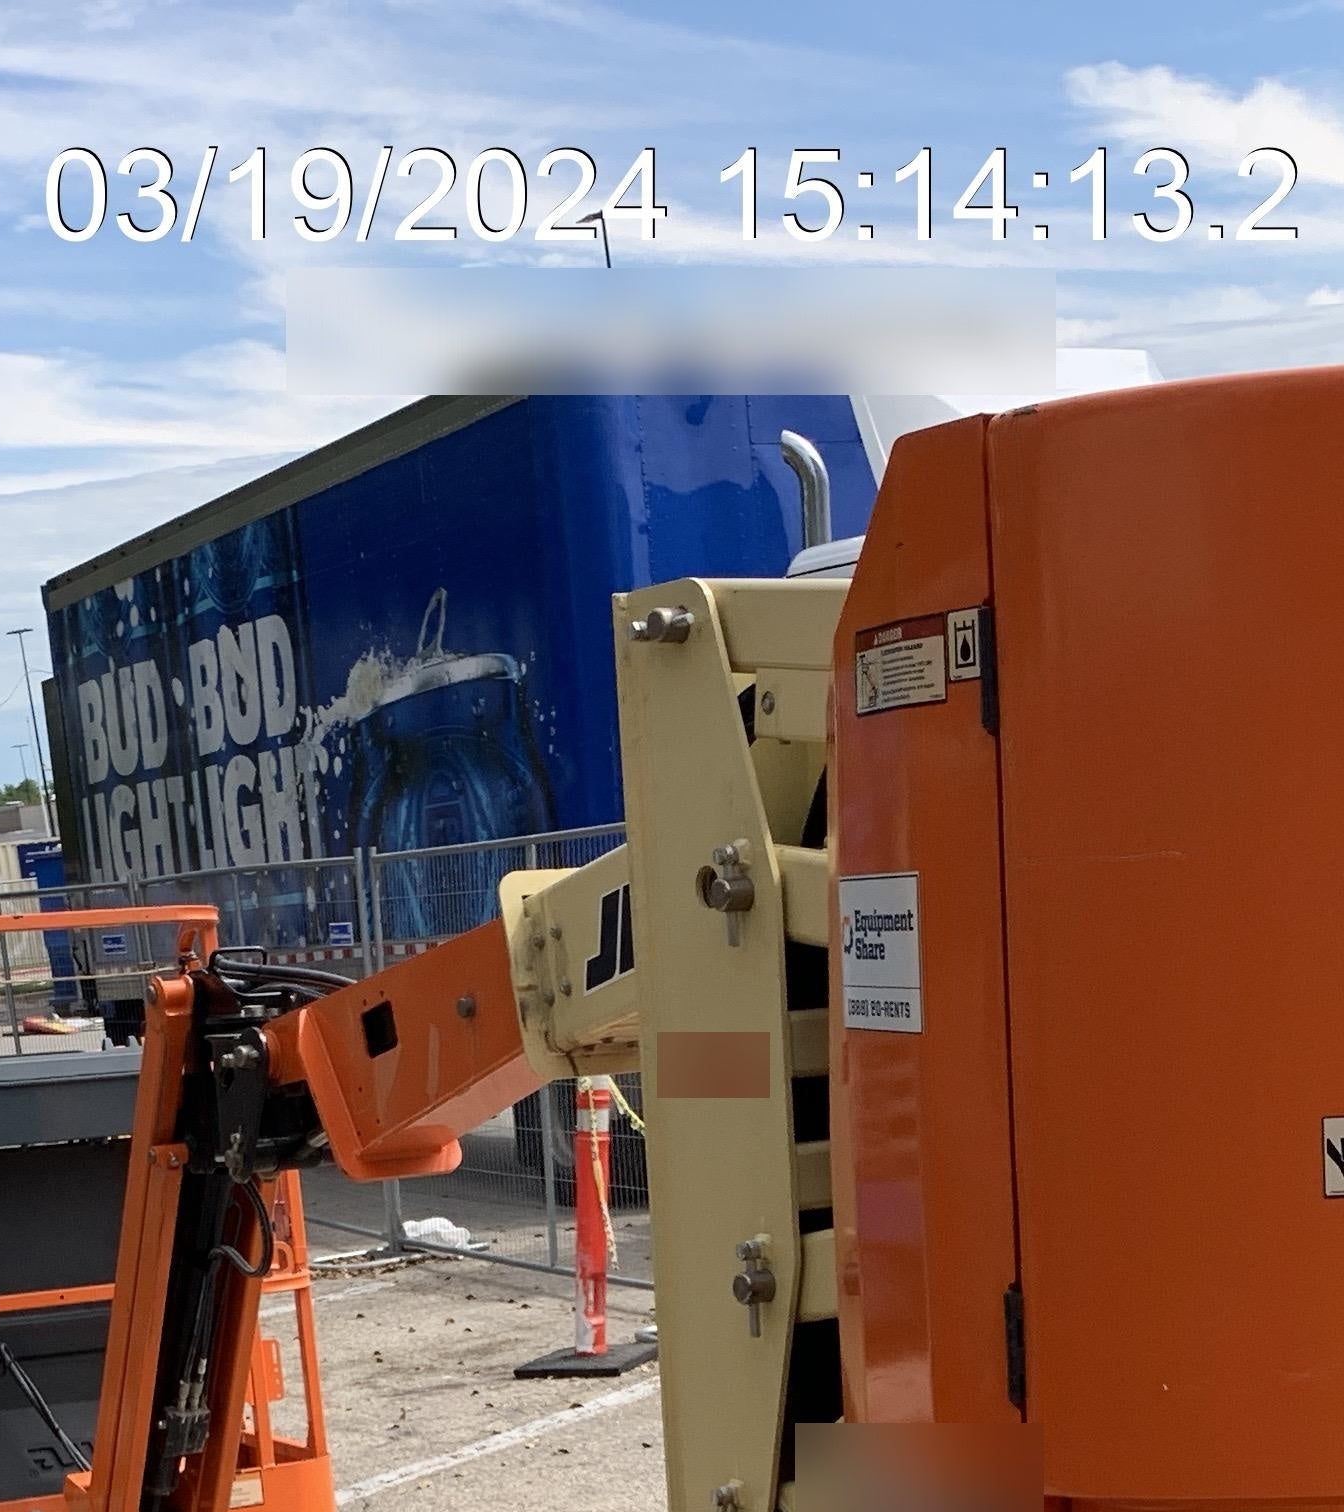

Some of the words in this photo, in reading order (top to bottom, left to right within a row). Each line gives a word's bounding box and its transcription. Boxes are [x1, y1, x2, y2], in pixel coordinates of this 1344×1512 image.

[78, 658, 168, 785] BUD
[188, 614, 296, 756] BUD
[83, 776, 191, 886] LIGHT
[854, 909, 914, 938] Equipment
[855, 938, 886, 960] Share
